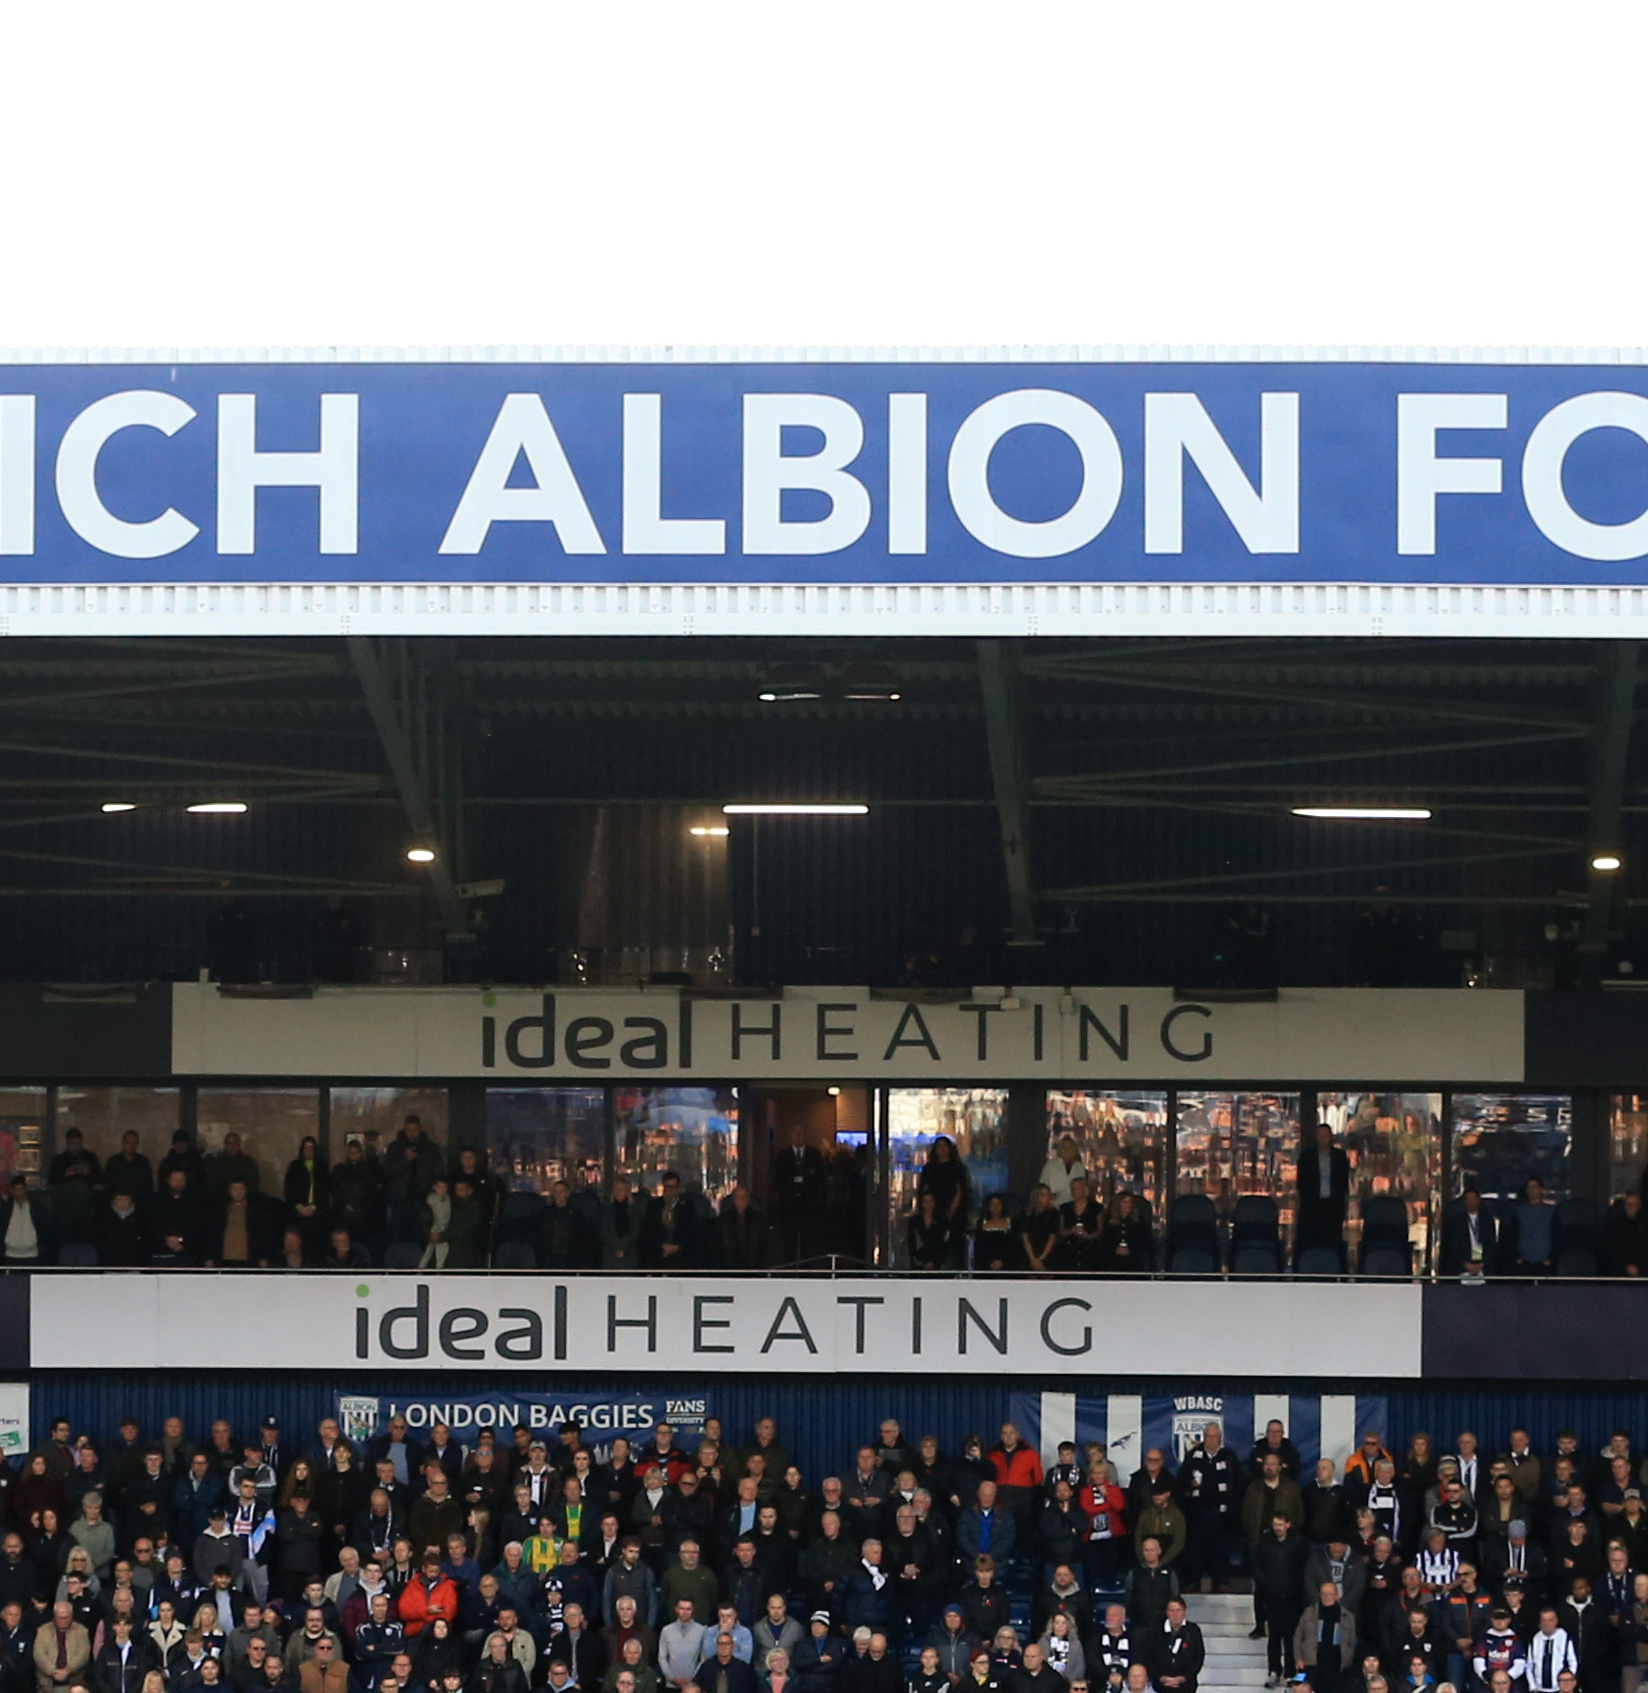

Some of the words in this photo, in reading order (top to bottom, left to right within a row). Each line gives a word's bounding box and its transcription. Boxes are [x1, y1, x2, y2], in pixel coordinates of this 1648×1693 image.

[438, 389, 1299, 557] ALBION
[483, 993, 691, 1069] ideal
[732, 1002, 1212, 1062] HEATING
[356, 1284, 567, 1360] ideal
[608, 1295, 1092, 1356] HEATING
[389, 1404, 519, 1428] LONDON
[530, 1405, 653, 1429] BAGGIES
[666, 1400, 705, 1412] FANS
[1173, 1397, 1223, 1412] WBASC
